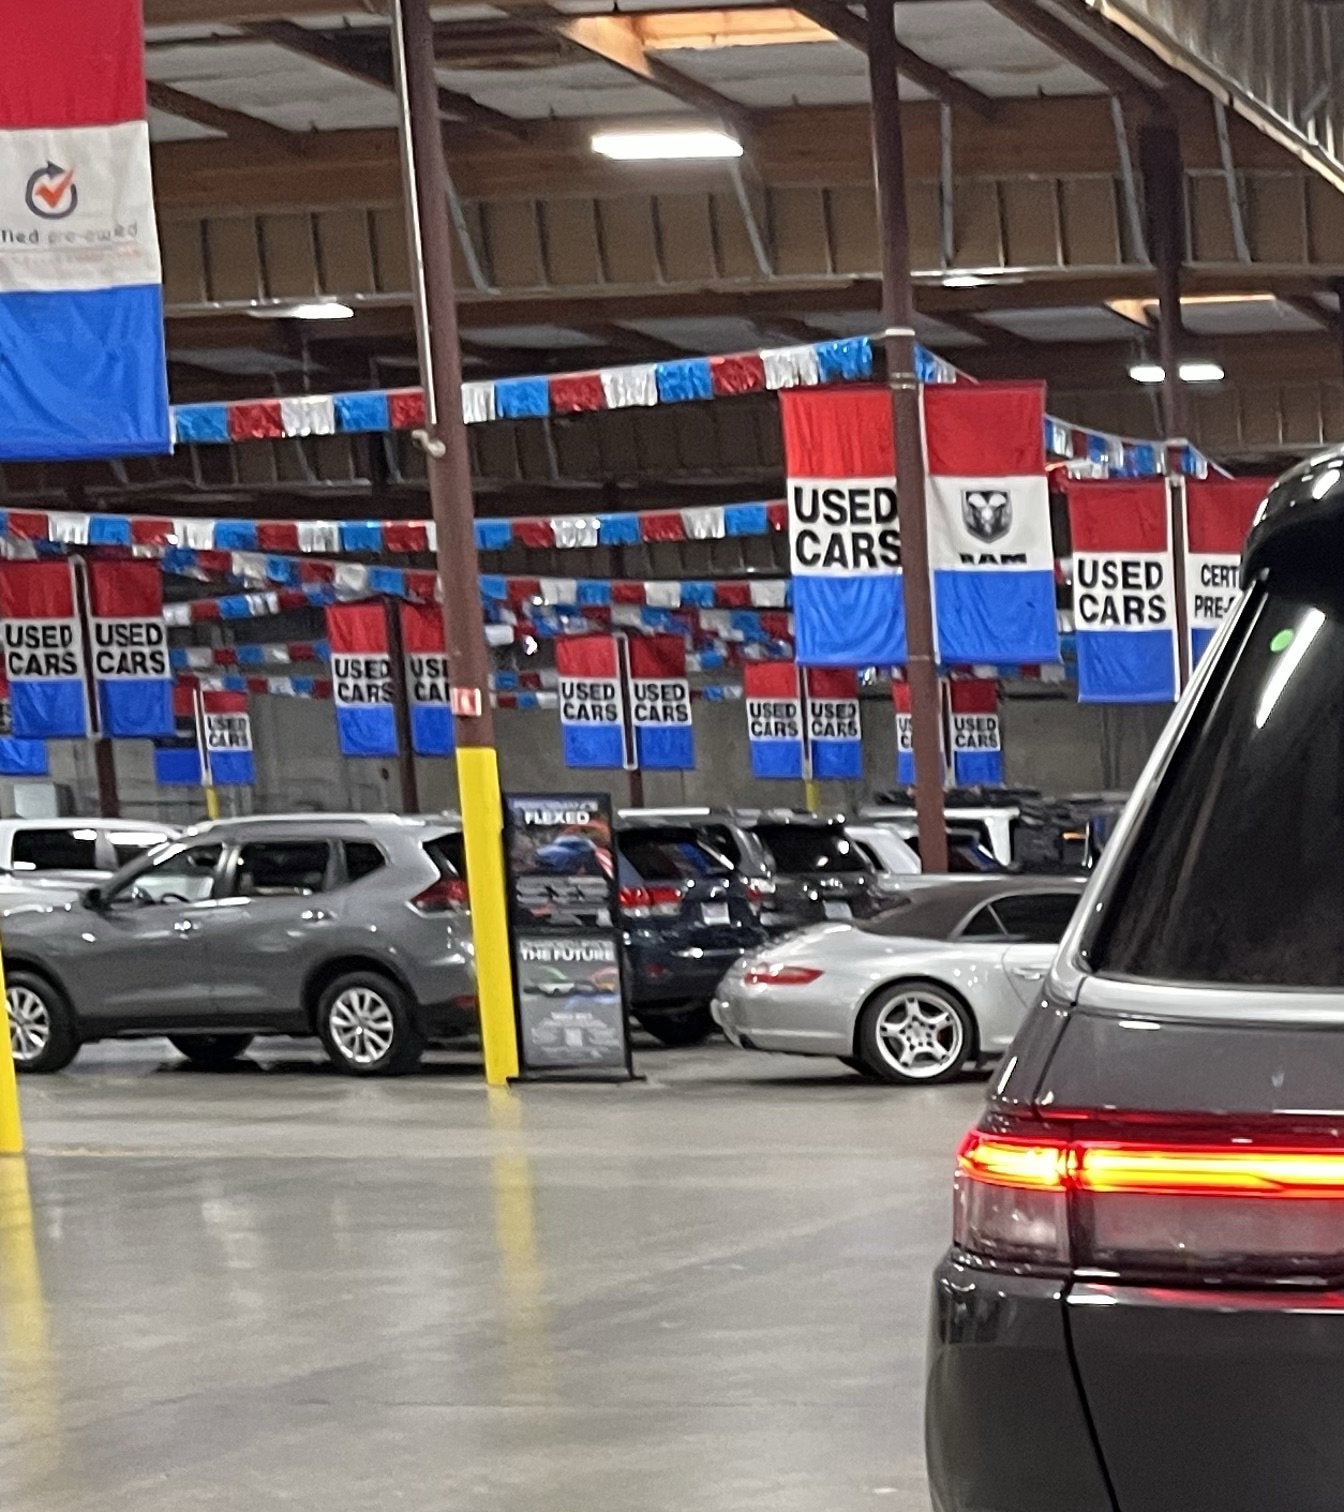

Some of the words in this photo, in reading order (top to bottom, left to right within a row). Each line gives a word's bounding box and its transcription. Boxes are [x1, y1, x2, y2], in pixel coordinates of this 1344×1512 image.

[794, 487, 897, 526] USED
[796, 530, 901, 568] CARS
[1078, 559, 1163, 590] USED
[1201, 564, 1239, 588] CERT
[1079, 594, 1166, 624] CARS
[5, 624, 73, 648] USED
[95, 623, 163, 646] USED
[8, 652, 78, 675] CARS
[96, 650, 166, 674] CARS
[335, 659, 390, 678] USED
[411, 659, 449, 678] US
[338, 682, 394, 702] CARS
[414, 682, 450, 701] CA
[562, 682, 616, 700] USED
[634, 682, 686, 701] USED
[563, 704, 618, 722] CARS
[634, 704, 689, 722] CARS
[749, 702, 797, 719] USED
[811, 702, 856, 719] USED
[751, 720, 799, 737] CARS
[811, 720, 858, 737] CARS
[954, 717, 996, 732] USED
[954, 734, 998, 749] CARS
